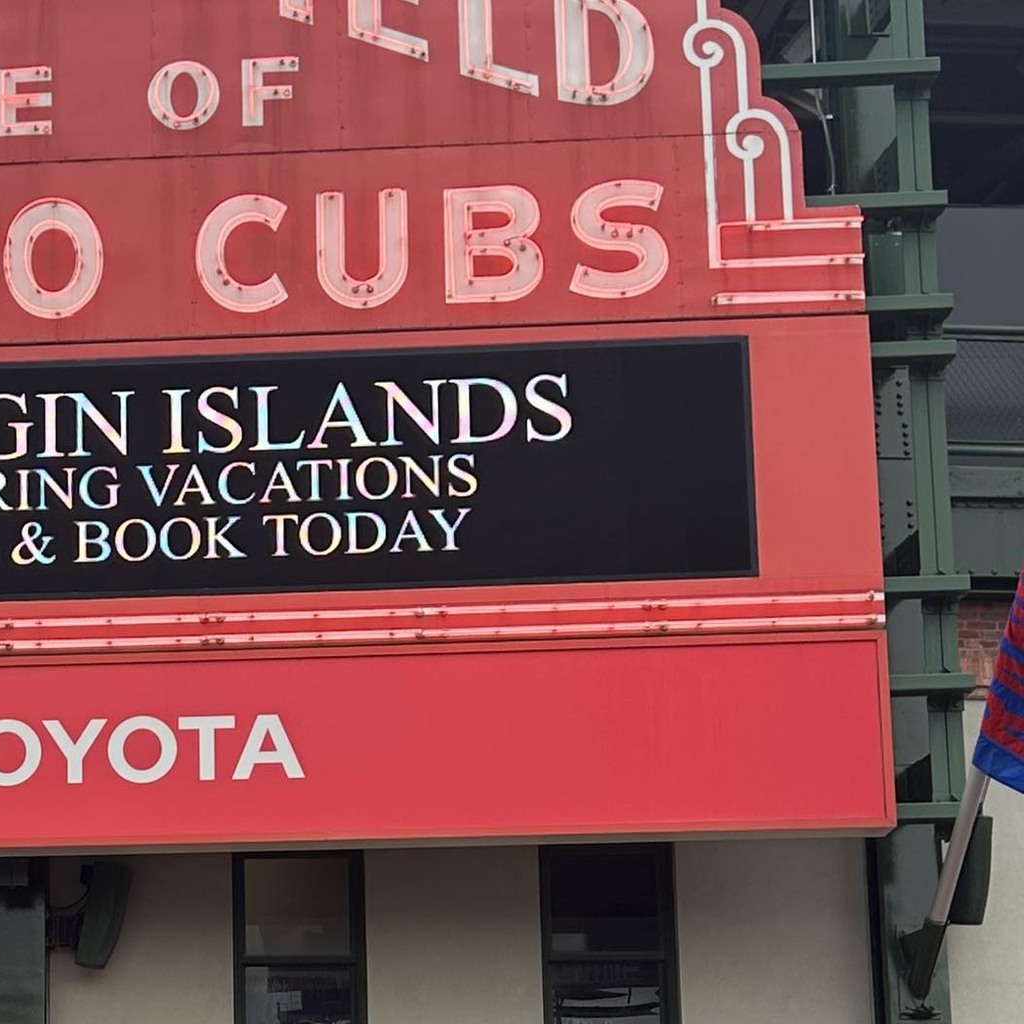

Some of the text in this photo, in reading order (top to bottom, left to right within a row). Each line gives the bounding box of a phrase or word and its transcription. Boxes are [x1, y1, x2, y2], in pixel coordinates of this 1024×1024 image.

[147, 56, 300, 131] OF
[195, 180, 669, 313] CUBS
[161, 373, 573, 455] ISLANDS
[136, 453, 479, 507] VACATIONS
[11, 522, 57, 565] &
[74, 515, 247, 563] BOOK
[262, 507, 472, 557] TODAY
